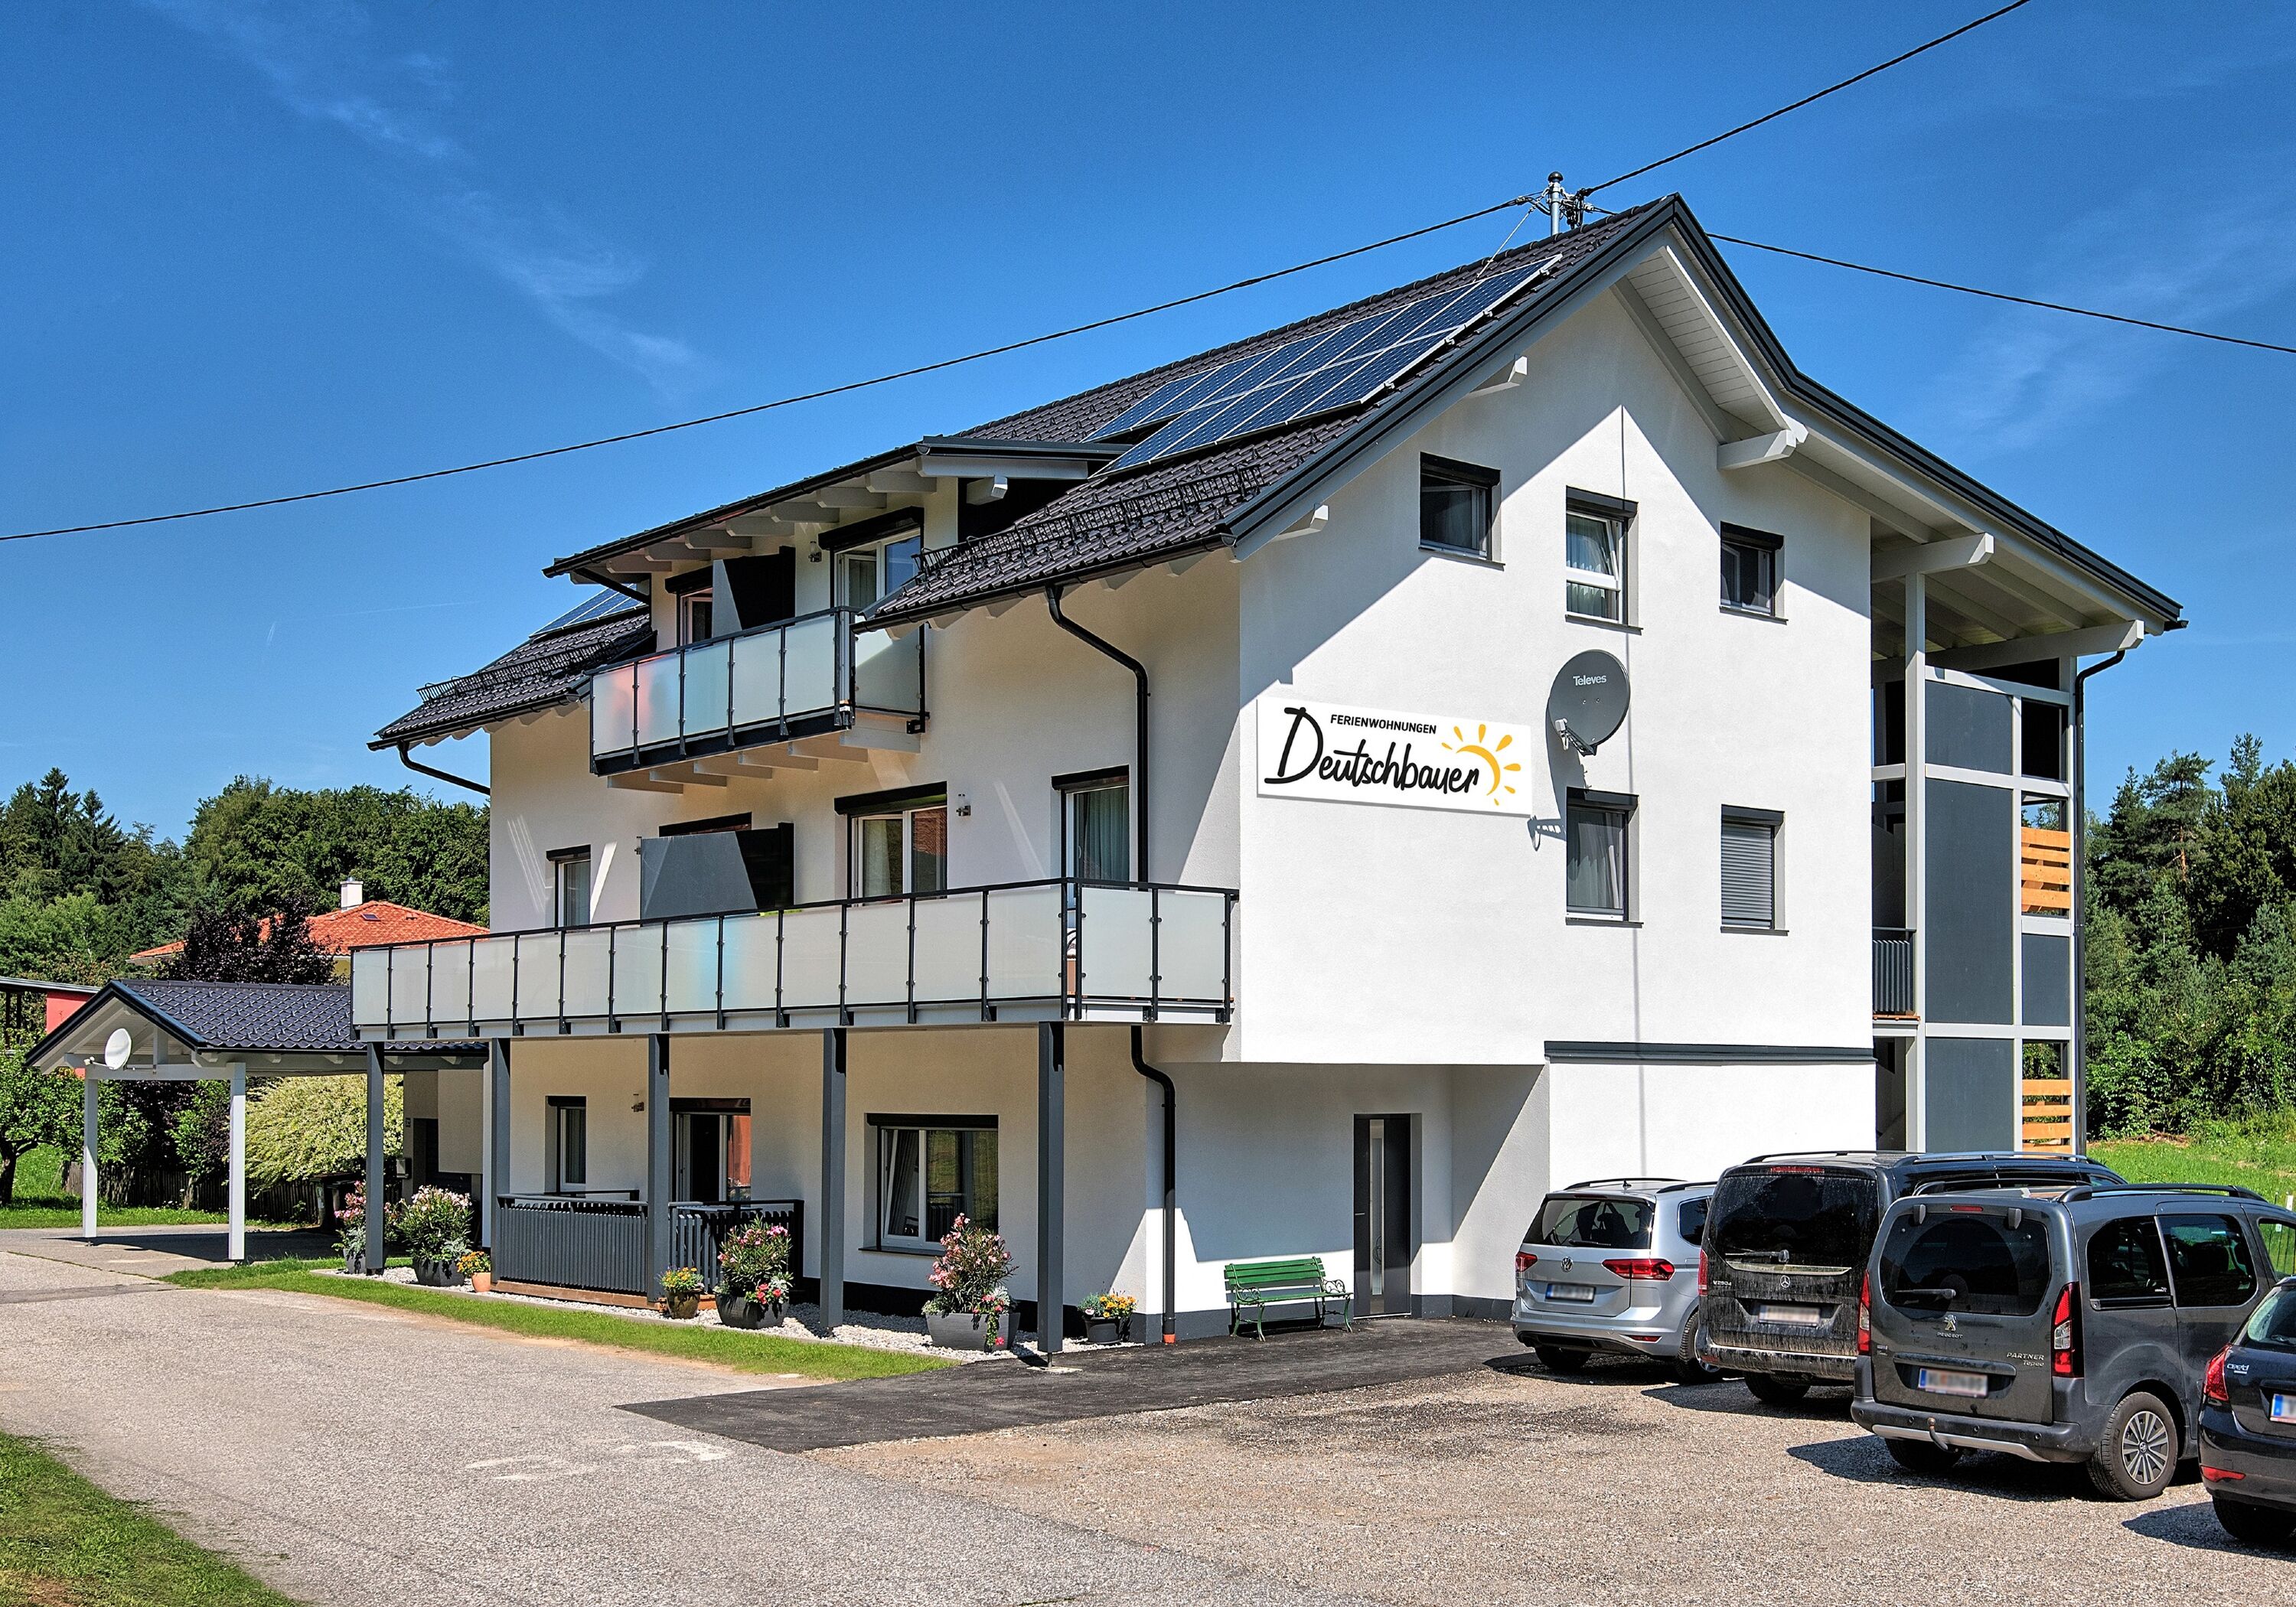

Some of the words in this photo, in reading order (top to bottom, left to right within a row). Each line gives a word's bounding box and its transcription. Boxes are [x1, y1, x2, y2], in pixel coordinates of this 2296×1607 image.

[1573, 674, 1607, 686] Televes
[1330, 714, 1437, 735] FERIENWOHNUNGEN
[1264, 706, 1479, 794] Deutschbauer
[2006, 1351, 2045, 1361] PARTNER
